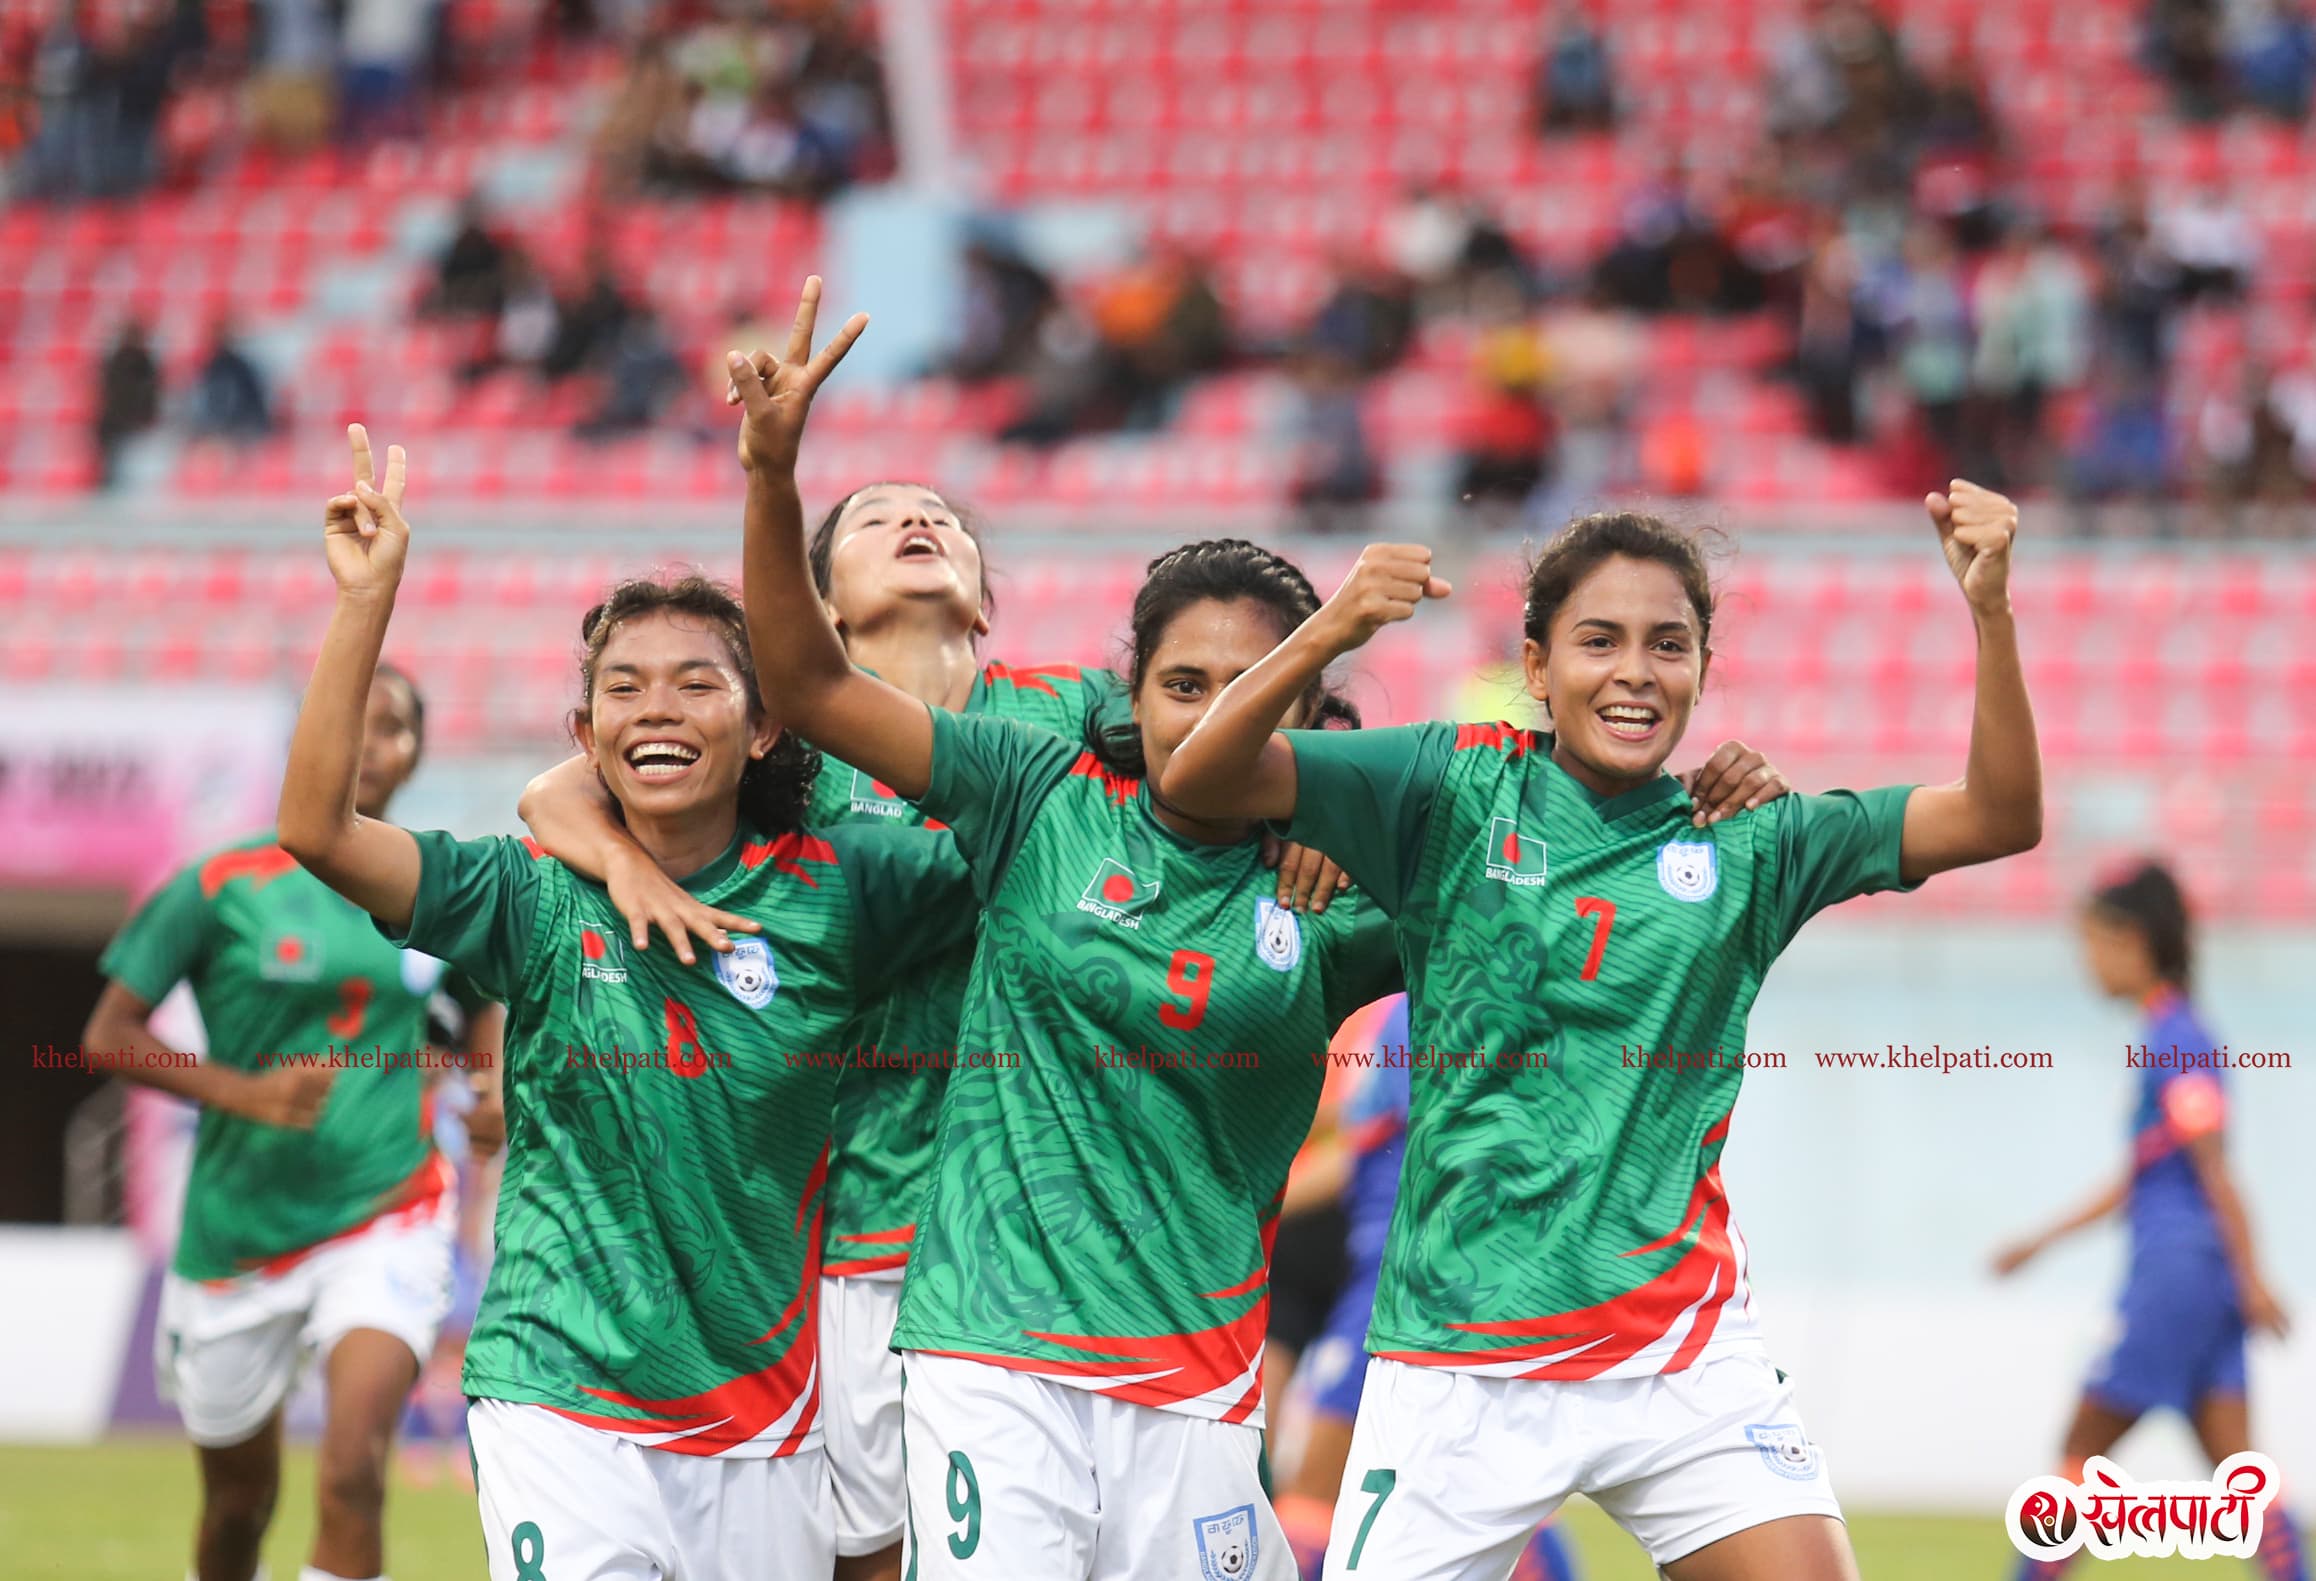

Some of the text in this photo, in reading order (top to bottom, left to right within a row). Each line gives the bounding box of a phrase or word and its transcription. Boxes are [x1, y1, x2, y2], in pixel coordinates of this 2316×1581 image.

[850, 801, 902, 818] BANGLAD
[1076, 899, 1140, 930] BANGLADESH
[1574, 896, 1617, 982] 7
[1158, 949, 1216, 1032] 9
[664, 997, 708, 1078] 8
[946, 1450, 981, 1560] 9
[1345, 1469, 1397, 1571] 7
[511, 1520, 548, 1581] 8
